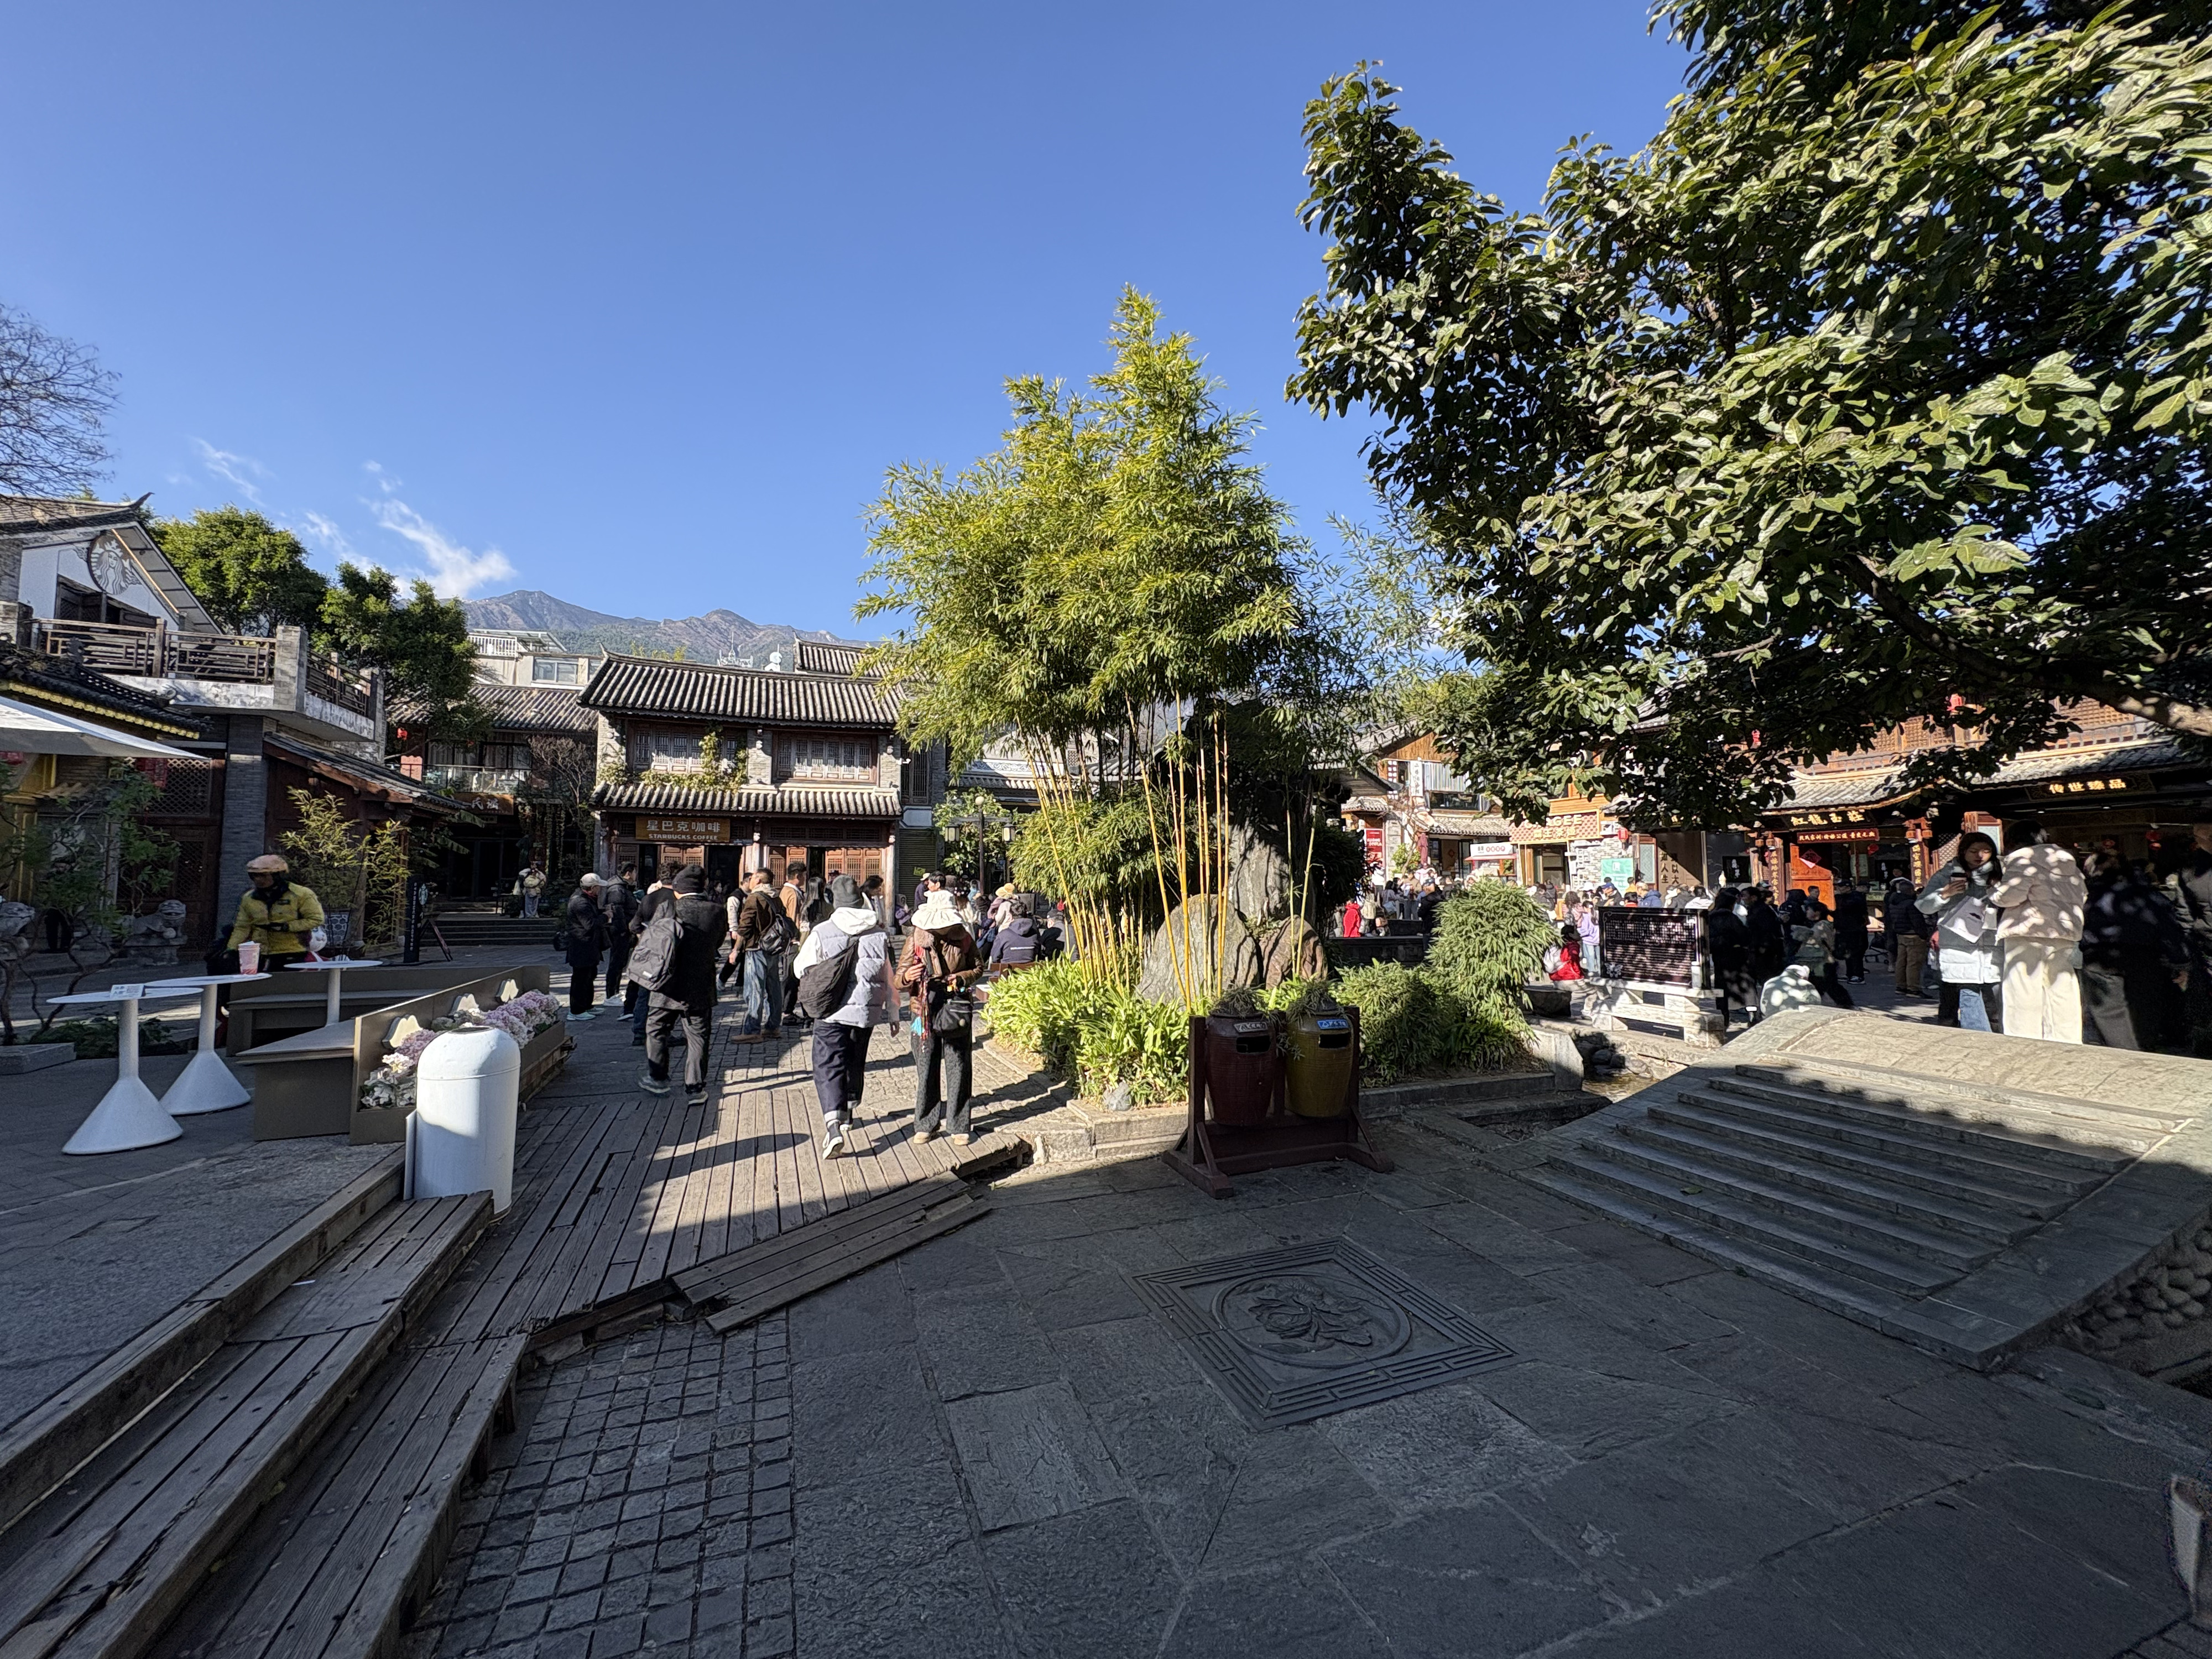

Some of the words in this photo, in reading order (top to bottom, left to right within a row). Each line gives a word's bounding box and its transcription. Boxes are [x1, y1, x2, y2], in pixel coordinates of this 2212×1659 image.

[646, 820, 721, 833] 星巴克咖啡
[1524, 814, 1582, 829] CAGEE
